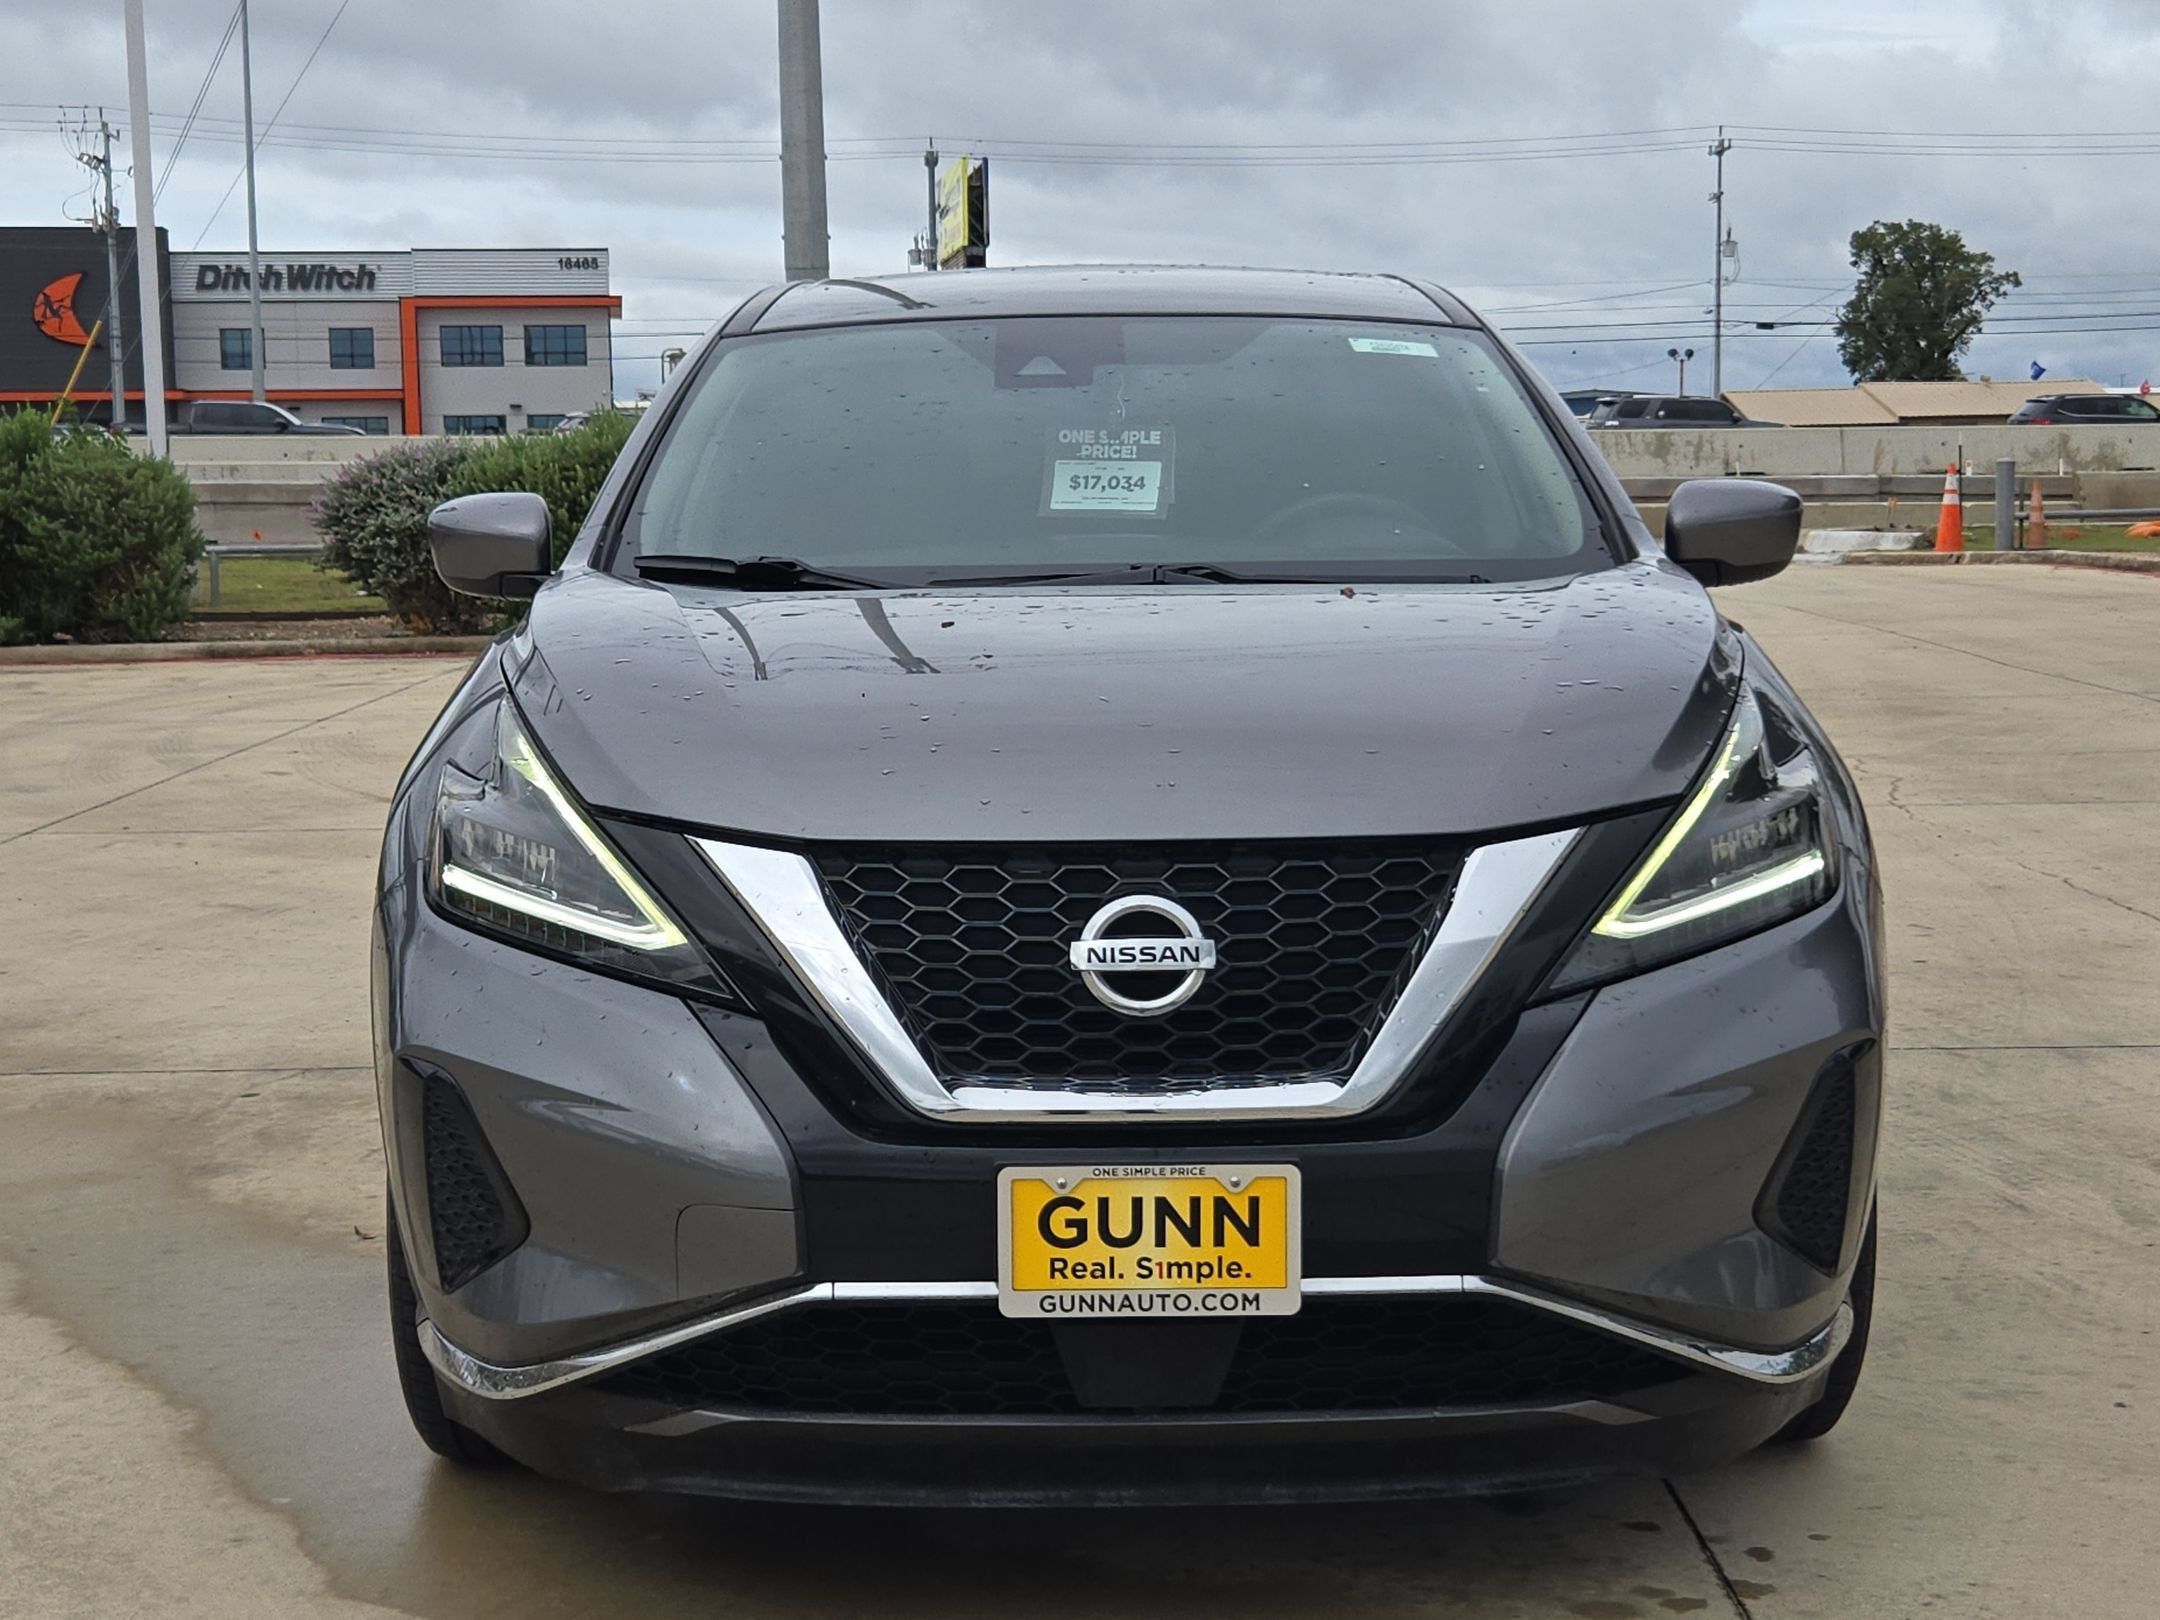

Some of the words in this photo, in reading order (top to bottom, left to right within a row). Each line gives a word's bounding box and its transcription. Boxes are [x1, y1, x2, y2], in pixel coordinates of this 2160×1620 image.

[286, 264, 376, 291] Witch
[1058, 429, 1096, 443] ONE
[1080, 444, 1137, 459] PRICE!
[1068, 474, 1146, 493] $17,034
[1087, 946, 1200, 964] NISSAN
[1092, 1167, 1119, 1177] ONE
[1123, 1167, 1167, 1177] SIMPLE
[1170, 1167, 1206, 1176] PRICE
[1037, 1196, 1260, 1249] GUNN
[1049, 1256, 1124, 1280] Real.
[1039, 1293, 1261, 1314] GUNNAUTO.COM
